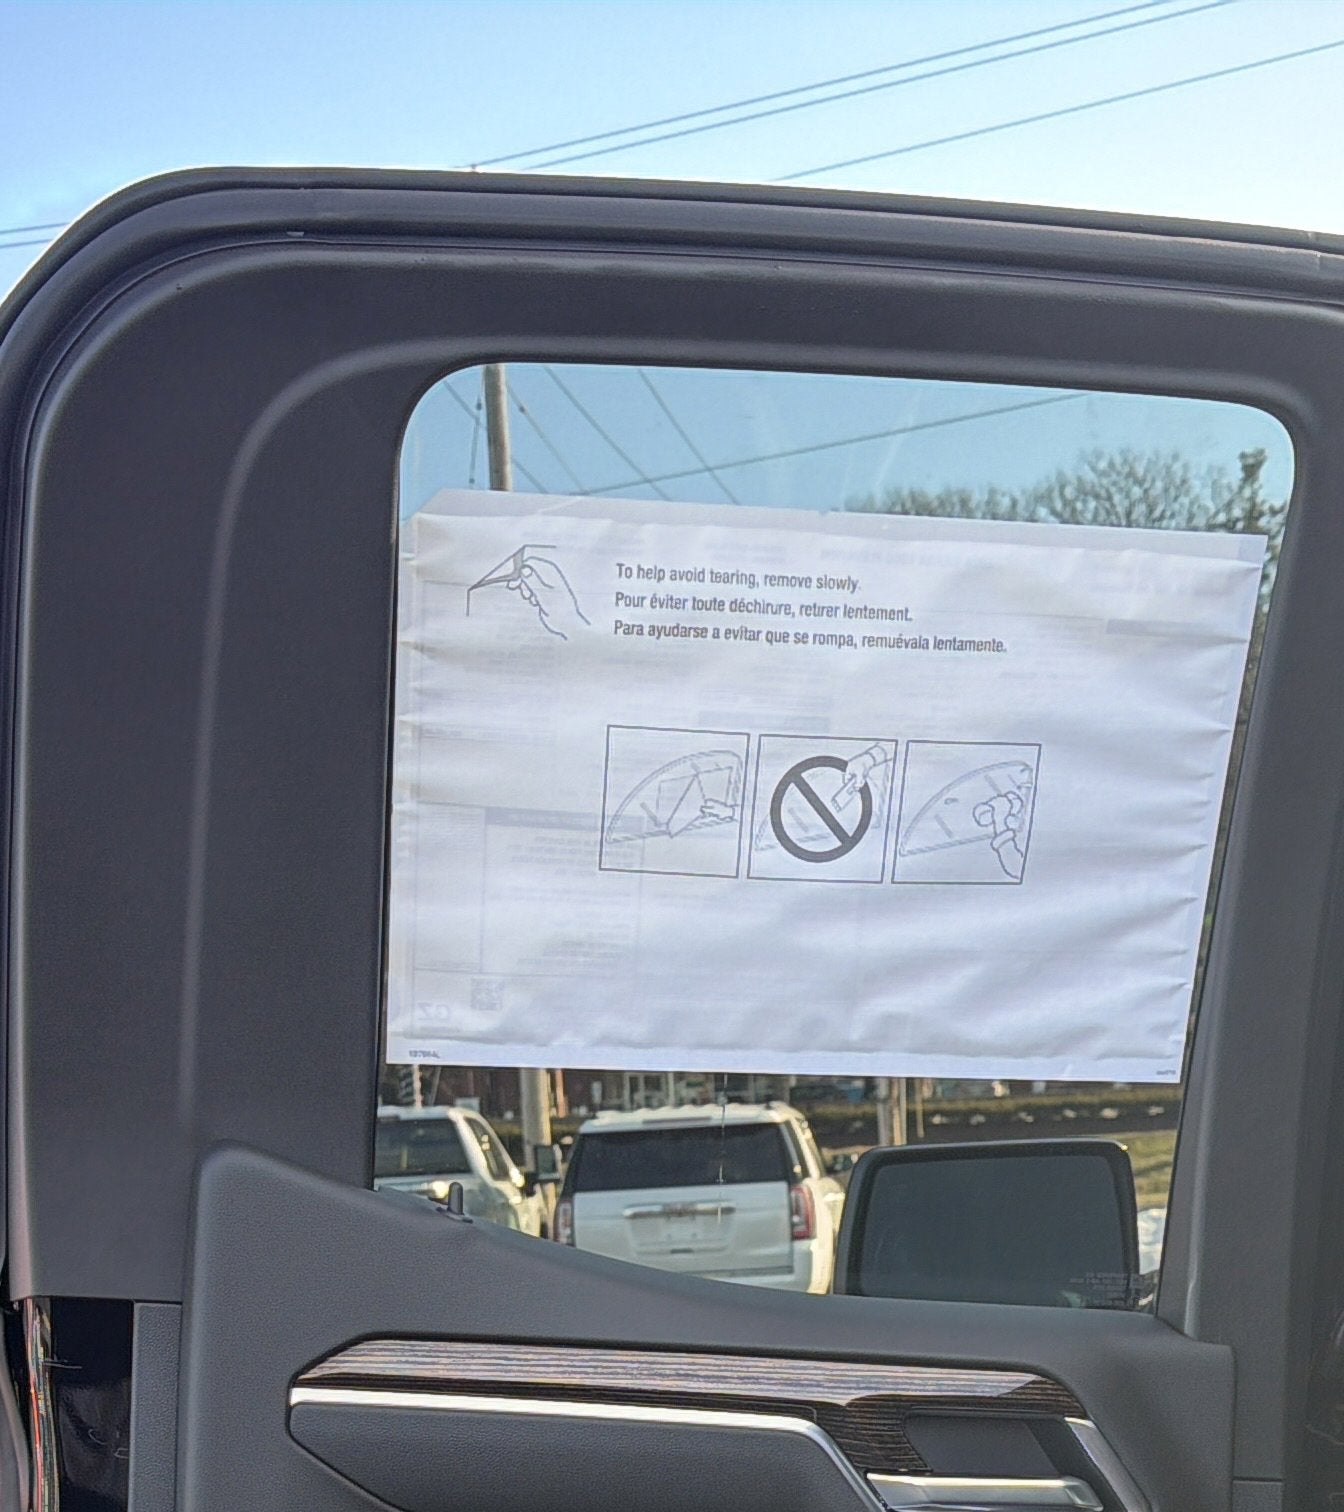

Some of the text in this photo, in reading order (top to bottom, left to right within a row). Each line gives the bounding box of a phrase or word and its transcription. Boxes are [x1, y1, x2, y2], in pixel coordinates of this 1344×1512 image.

[616, 563, 862, 594] To help avoid tearing, remove slowly.
[615, 591, 914, 622] Pour éviter toute déchirure, retirer lentement.
[614, 620, 1007, 653] Para ayudarse a evitar que se rompa, remuévala lentamente.
